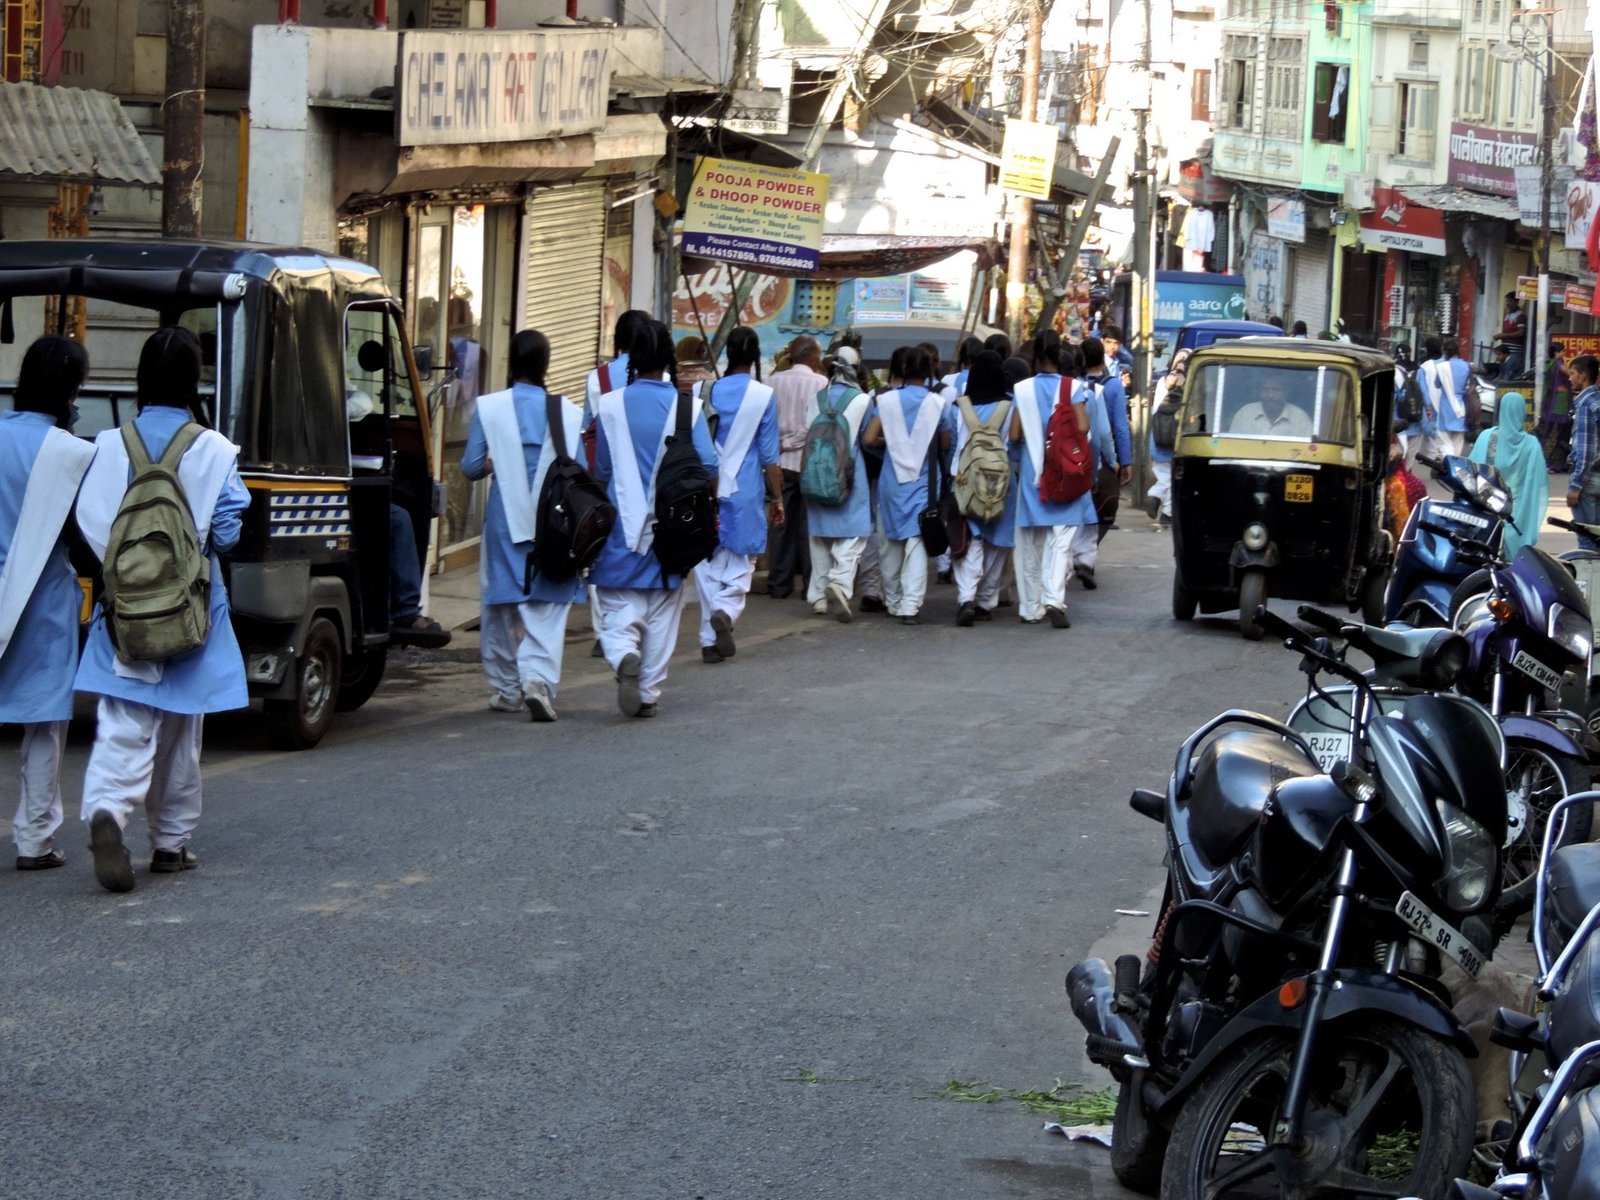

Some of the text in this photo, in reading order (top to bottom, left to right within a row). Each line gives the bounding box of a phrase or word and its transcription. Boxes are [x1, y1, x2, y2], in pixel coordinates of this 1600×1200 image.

[504, 51, 537, 124] ART
[706, 171, 815, 197] POOJA POWDER
[695, 186, 822, 214] & DHOOP POWDER
[686, 243, 698, 254] M.
[707, 235, 731, 246] Please
[731, 239, 760, 250] Contact
[760, 243, 778, 253] After
[784, 246, 797, 255] PM
[1310, 737, 1342, 751] RJ27
[1436, 928, 1452, 950] SR
